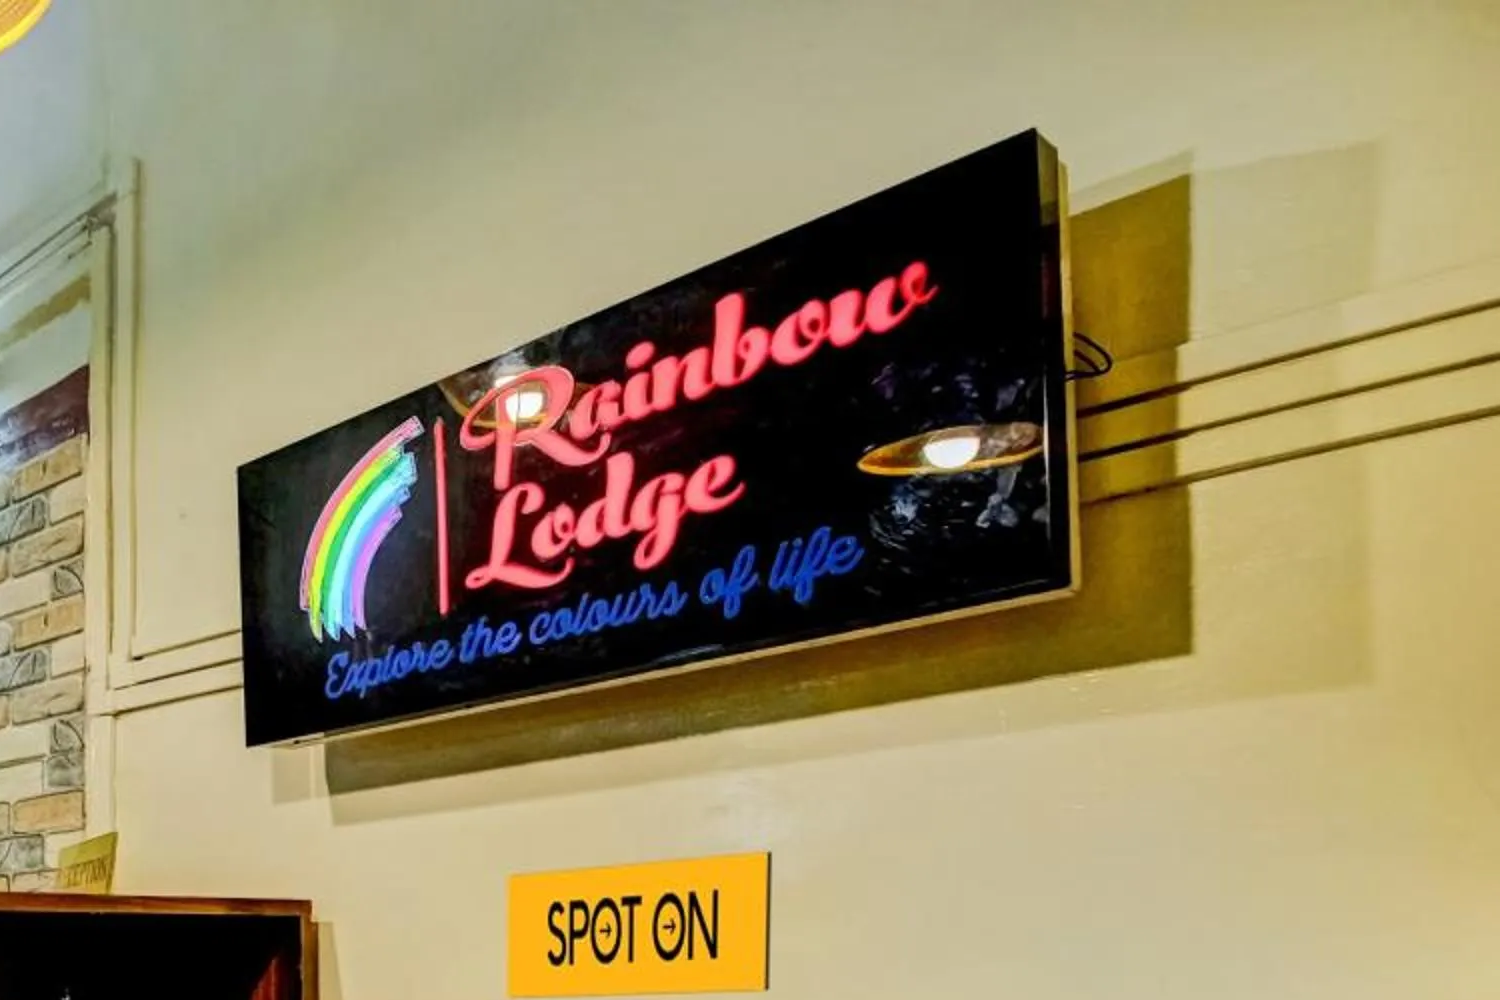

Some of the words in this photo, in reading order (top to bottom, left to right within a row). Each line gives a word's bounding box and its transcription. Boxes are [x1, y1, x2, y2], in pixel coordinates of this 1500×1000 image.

[460, 261, 938, 489] Rainbow
[465, 452, 744, 589] Lodge
[325, 645, 454, 699] Explore
[460, 615, 522, 663] the
[529, 581, 688, 645] colours
[699, 545, 759, 618] of
[769, 526, 865, 604] life
[548, 896, 642, 966] SPOT
[652, 889, 719, 961] ON
